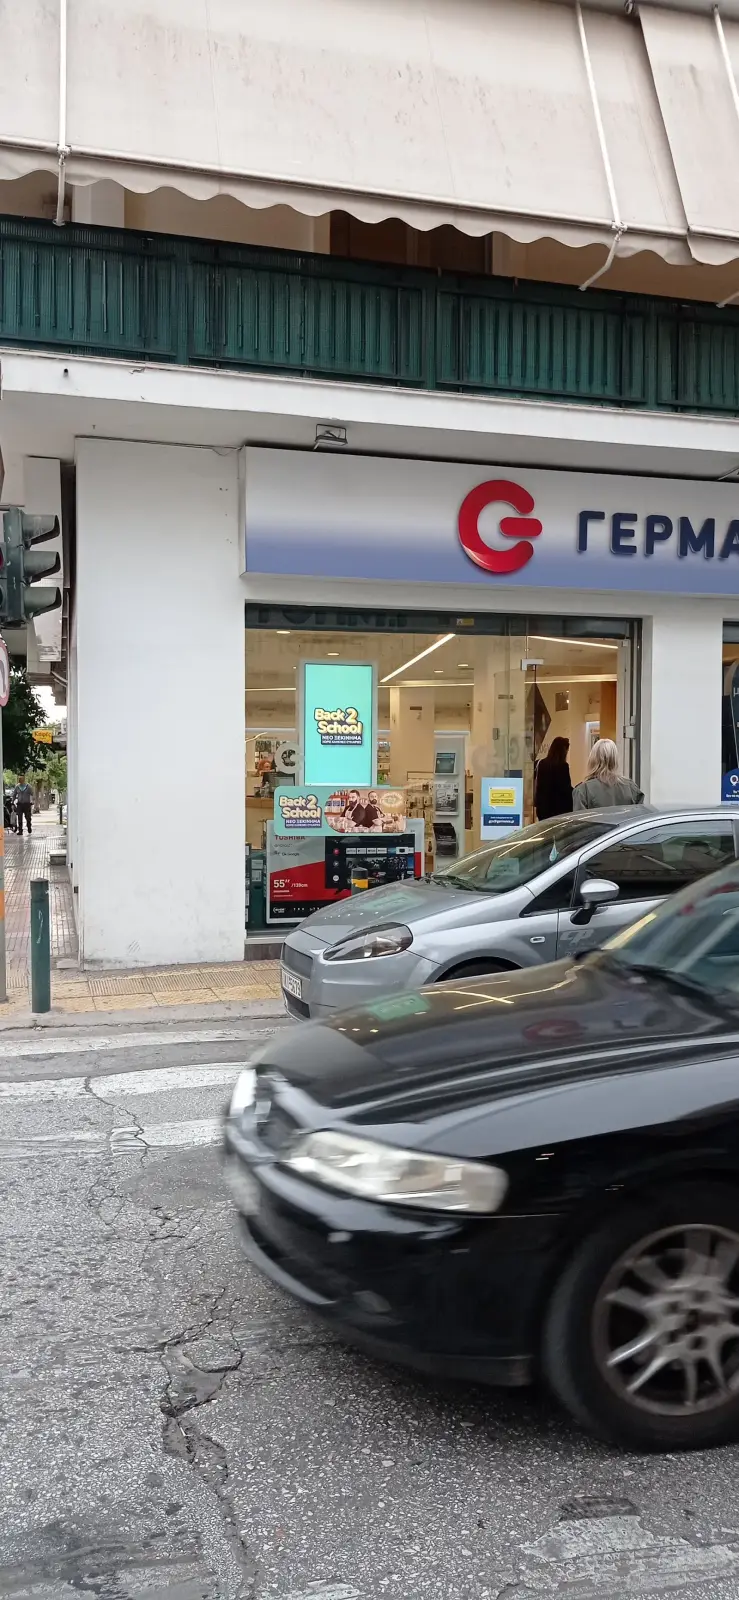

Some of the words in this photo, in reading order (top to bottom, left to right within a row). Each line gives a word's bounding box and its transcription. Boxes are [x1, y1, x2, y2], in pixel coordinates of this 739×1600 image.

[314, 708, 345, 721] Back
[345, 707, 358, 724] 2
[317, 721, 362, 734] School
[279, 796, 306, 807] Back
[306, 795, 317, 809] 2
[281, 807, 321, 819] School
